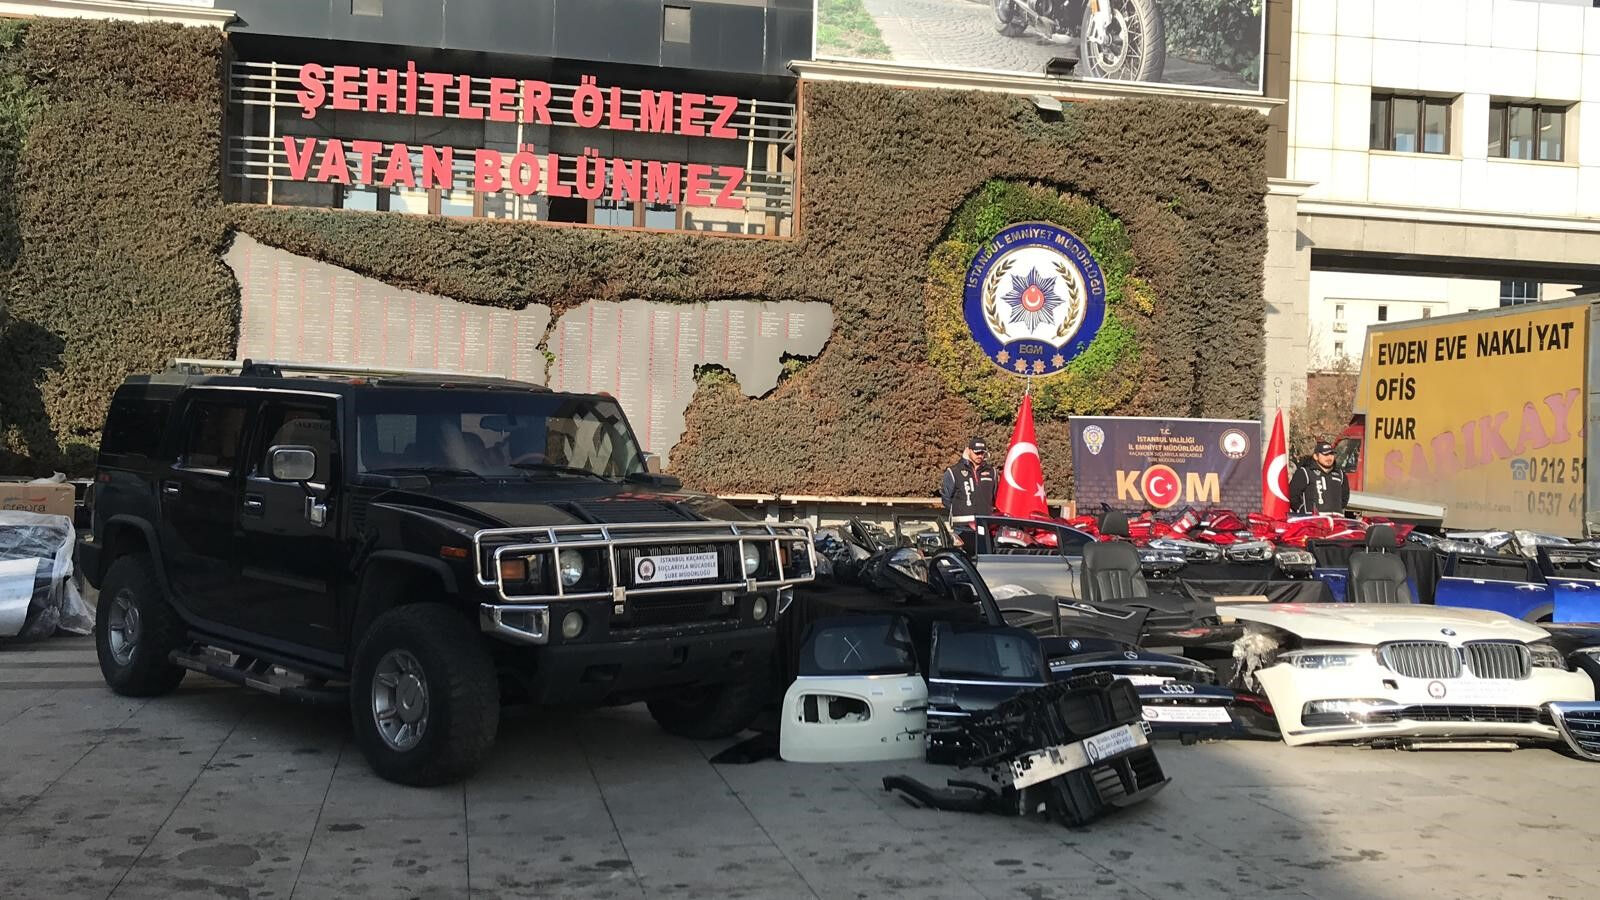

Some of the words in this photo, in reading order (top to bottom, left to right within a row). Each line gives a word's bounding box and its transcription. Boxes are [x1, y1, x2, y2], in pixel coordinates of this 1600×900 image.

[297, 60, 552, 125] ŞEHİTLER
[571, 74, 739, 139] ÖLMEZ
[282, 135, 454, 190] VATAN
[474, 142, 746, 209] BÖLÜNMEZ
[1019, 344, 1043, 355] EGM
[1377, 339, 1428, 366] EVDEN
[1435, 335, 1467, 362] EVE
[1476, 321, 1574, 358] NAKLİYAT
[1375, 372, 1416, 402] OFİS
[1374, 417, 1416, 440] FUAR
[1383, 387, 1586, 482] SARIKAY
